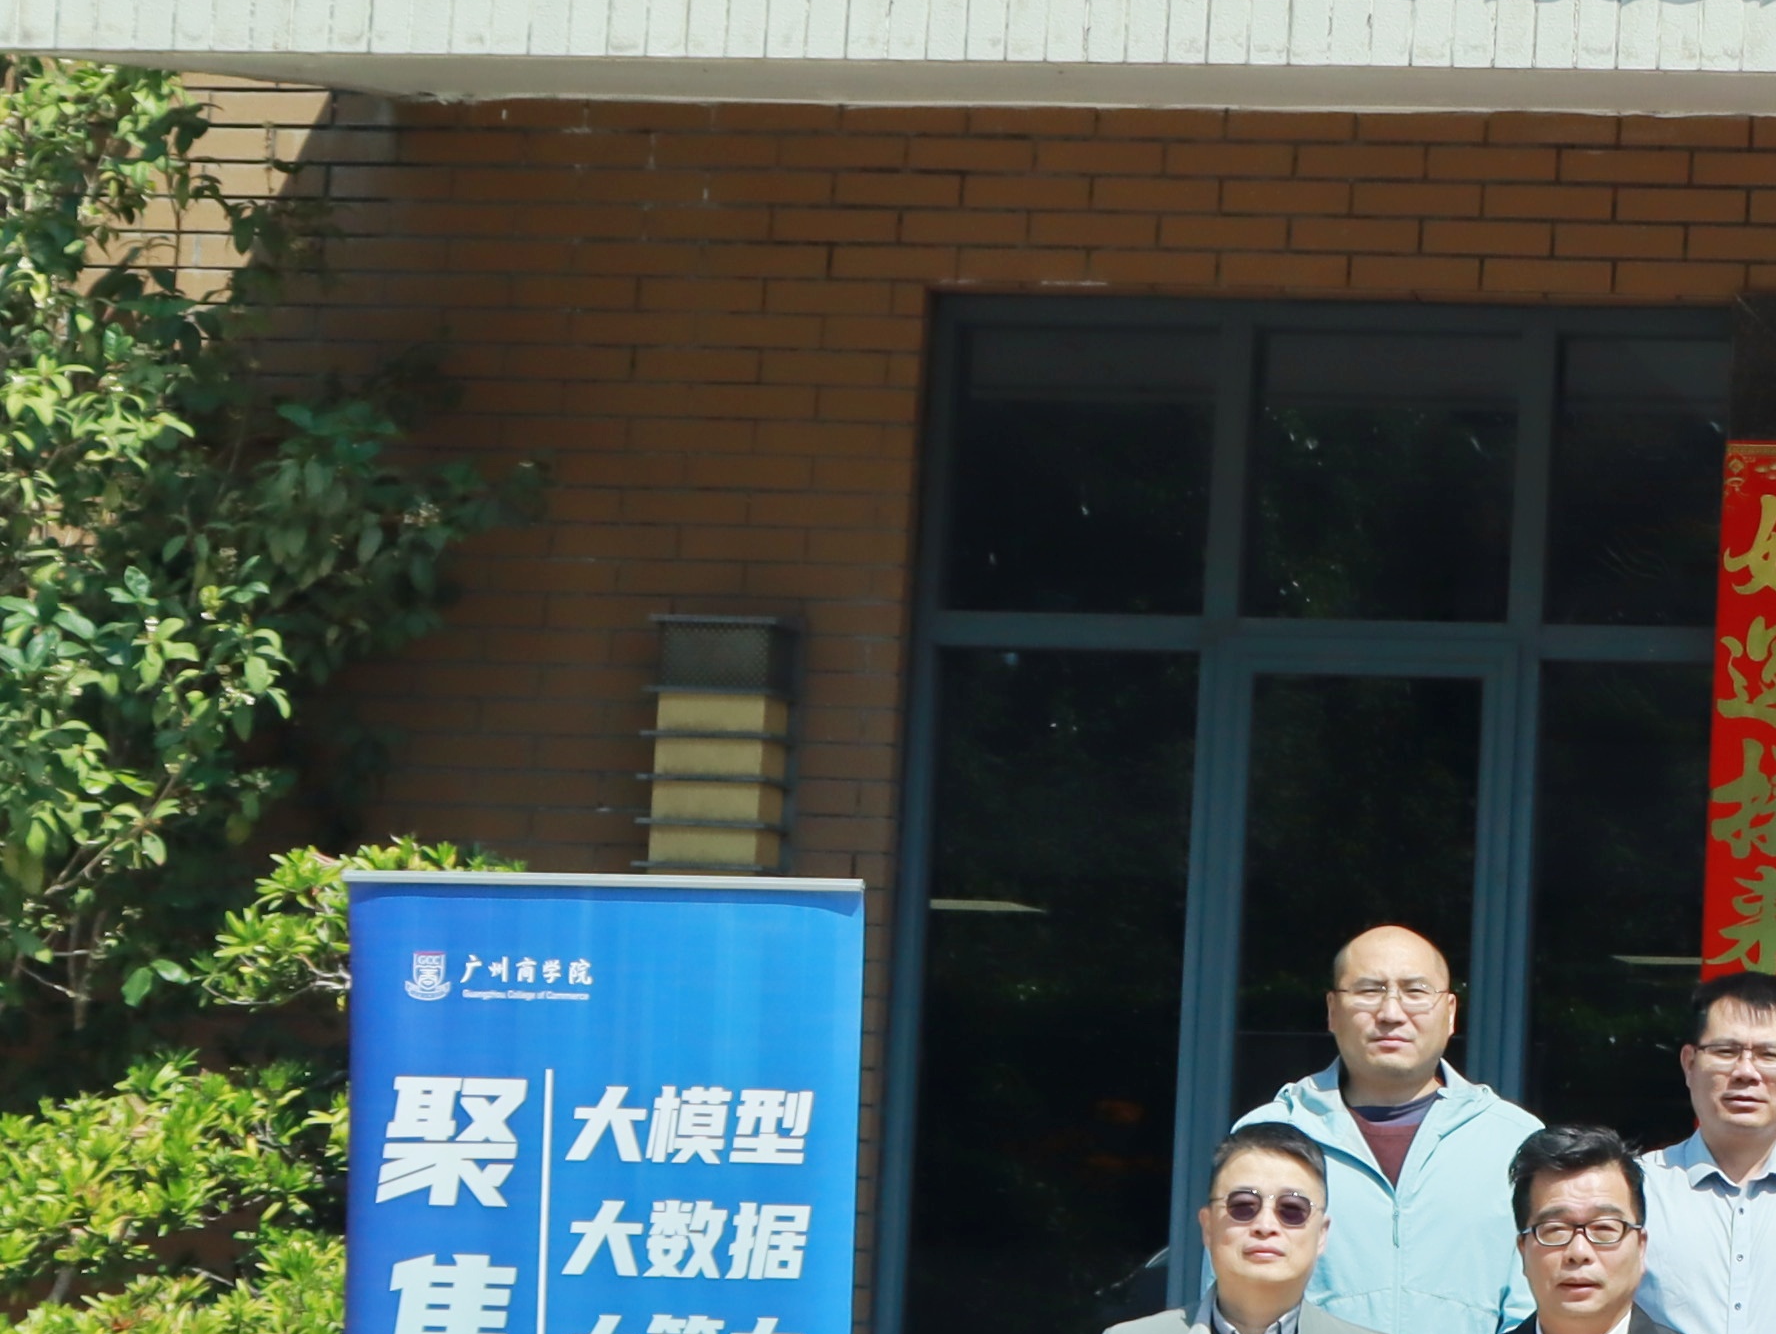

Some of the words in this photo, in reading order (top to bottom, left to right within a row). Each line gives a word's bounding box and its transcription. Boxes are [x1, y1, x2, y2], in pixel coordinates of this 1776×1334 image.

[460, 955, 594, 985] 广州商学院
[564, 1084, 814, 1165] 大模型
[561, 1199, 812, 1280] 大数据
